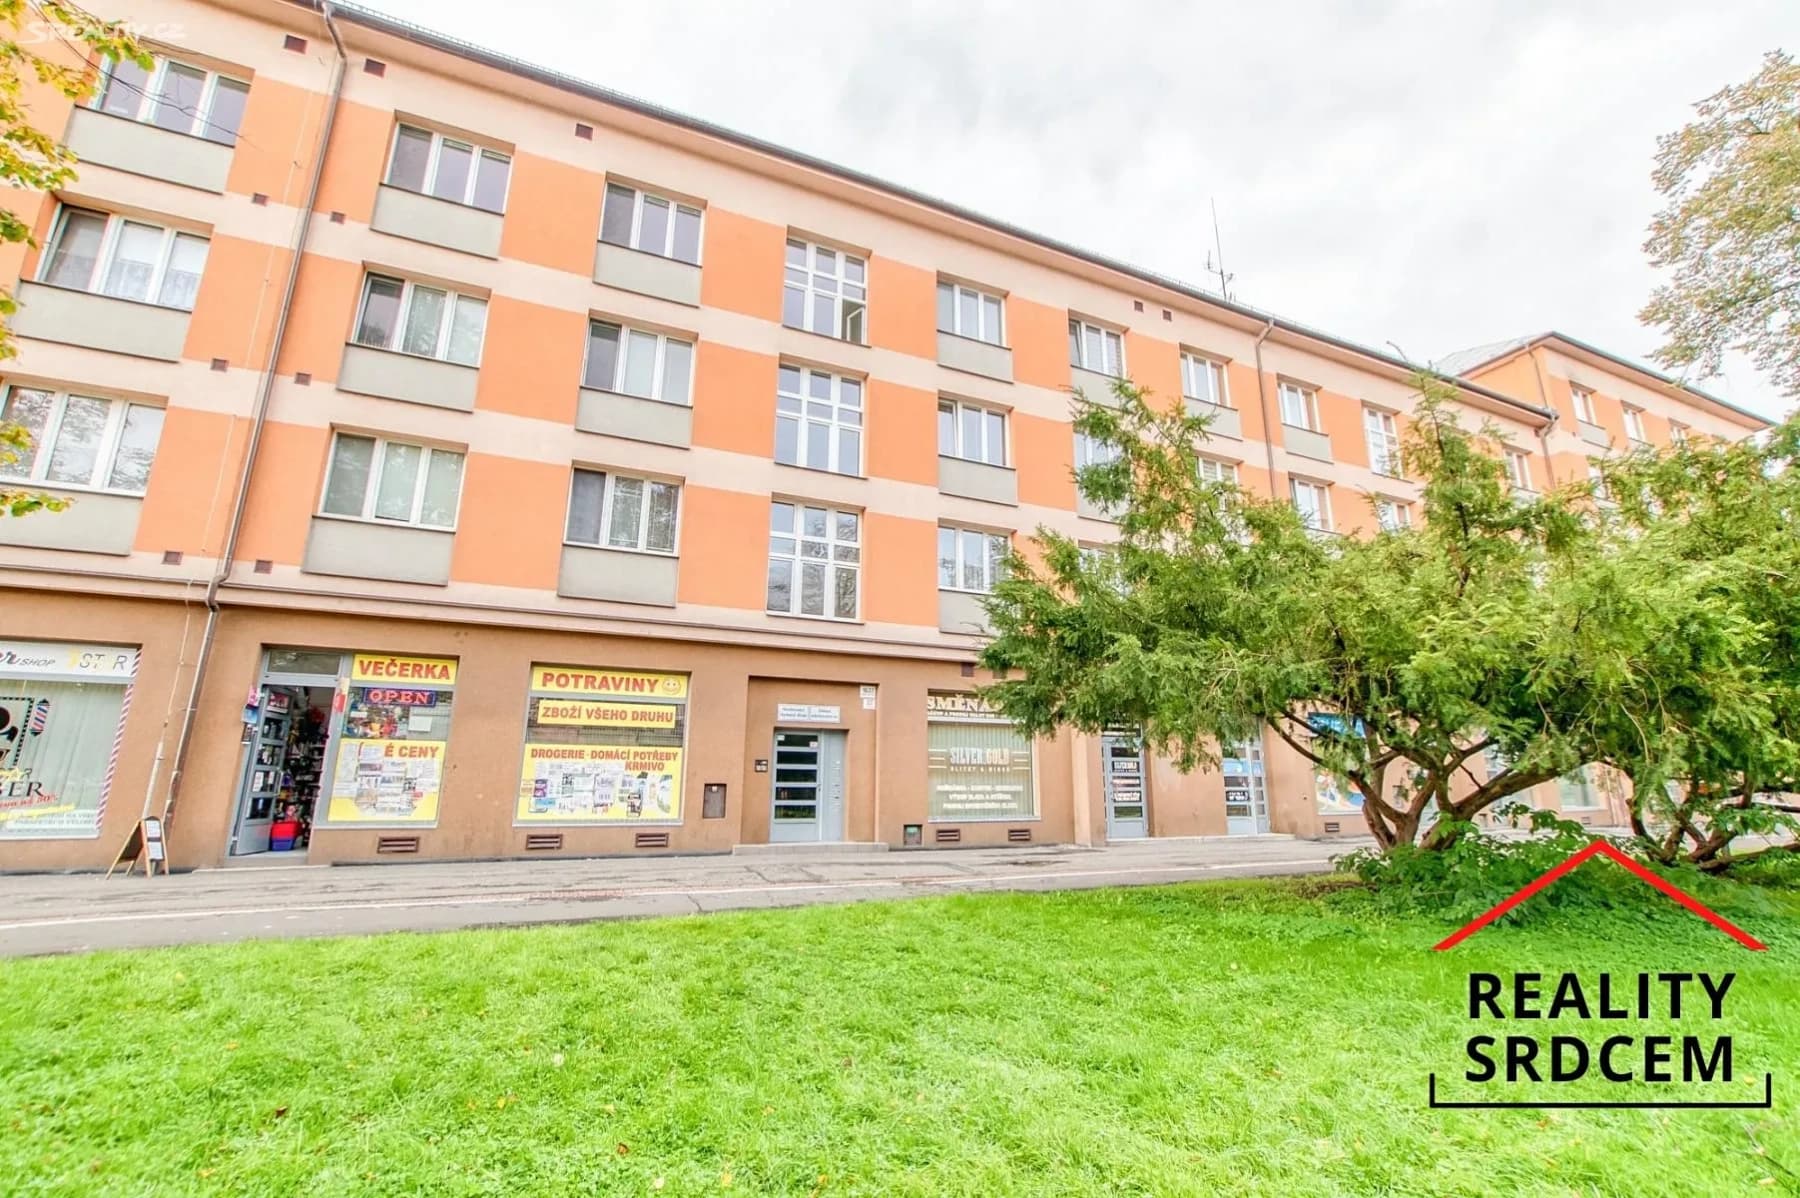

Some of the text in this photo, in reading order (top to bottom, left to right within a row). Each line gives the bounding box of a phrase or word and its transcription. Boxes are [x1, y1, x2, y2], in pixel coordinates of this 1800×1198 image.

[20, 657, 56, 667] SHOP
[359, 658, 450, 680] VEČERKA
[541, 672, 659, 693] POTRAVINY
[369, 688, 429, 704] OPEN
[541, 705, 674, 723] ZBOŽÍ VŠEHO DRUHU
[398, 745, 439, 758] CENY
[531, 748, 679, 761] DROGERIE DOMÁCÍ POTŘEBY
[624, 761, 665, 772] KRMIVO
